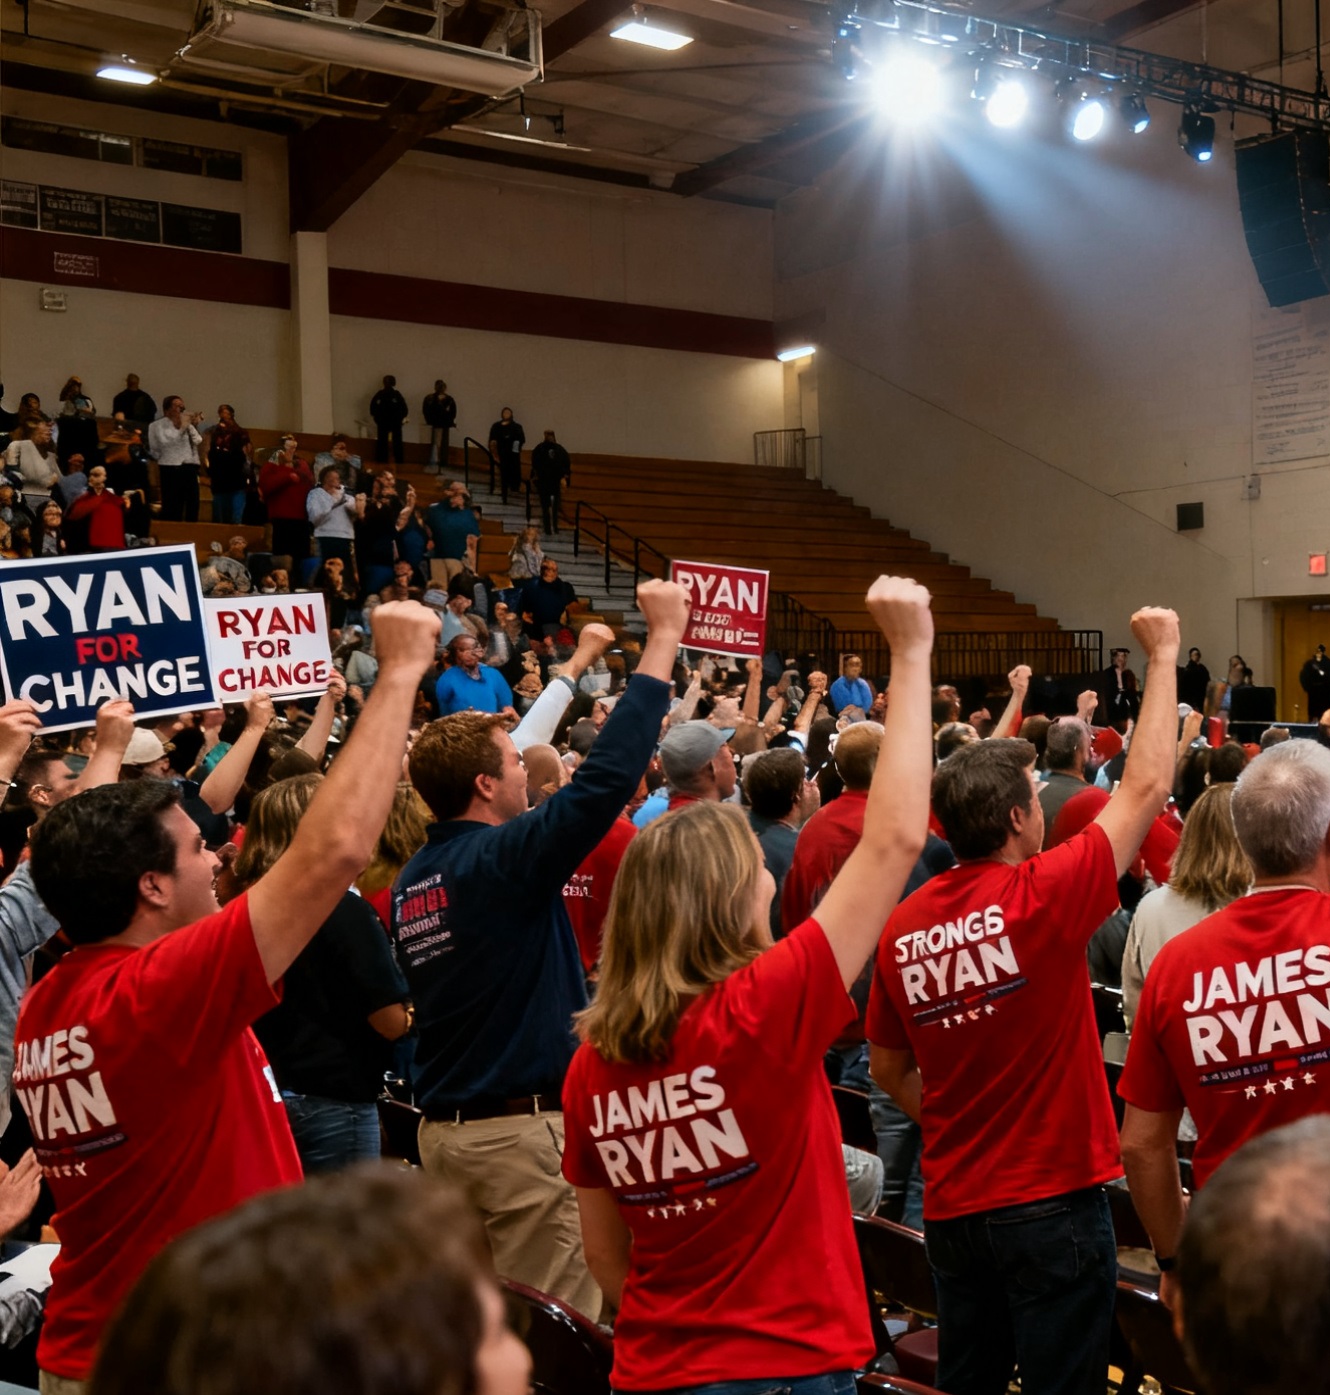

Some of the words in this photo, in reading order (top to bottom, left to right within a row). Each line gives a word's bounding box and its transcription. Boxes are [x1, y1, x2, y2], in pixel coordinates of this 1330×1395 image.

[0, 564, 192, 641] RYAN
[216, 603, 317, 639] RYAN
[75, 633, 143, 665] FOR
[218, 660, 330, 693] CHANGE
[242, 638, 292, 660] FOR
[20, 655, 205, 713] CHANGE
[900, 935, 1020, 1005] RYAN
[589, 1065, 726, 1138] JAMES
[595, 1107, 750, 1188] RYAN
